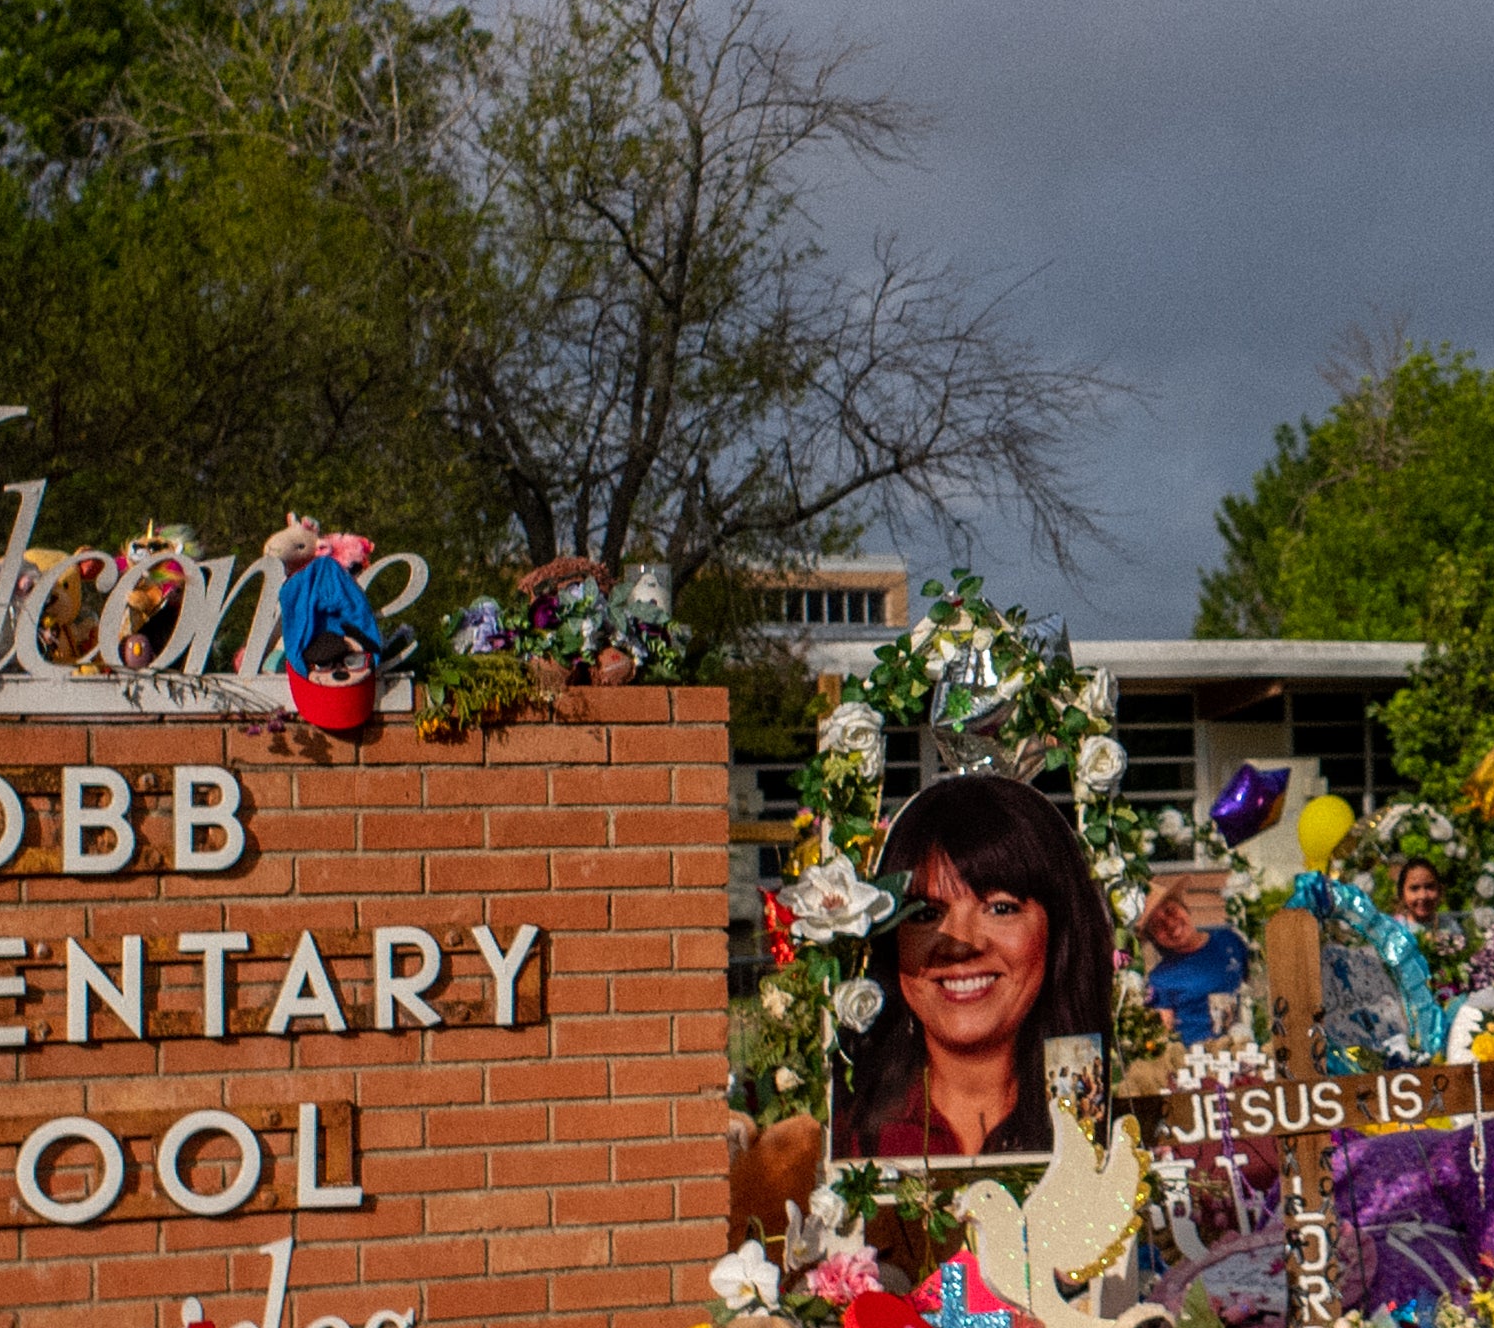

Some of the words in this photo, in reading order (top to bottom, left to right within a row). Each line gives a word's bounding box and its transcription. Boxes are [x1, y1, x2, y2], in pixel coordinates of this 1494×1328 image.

[1171, 1081, 1345, 1144] JESUS
[1377, 1073, 1422, 1122] IS
[1292, 1176, 1334, 1324] LOR
